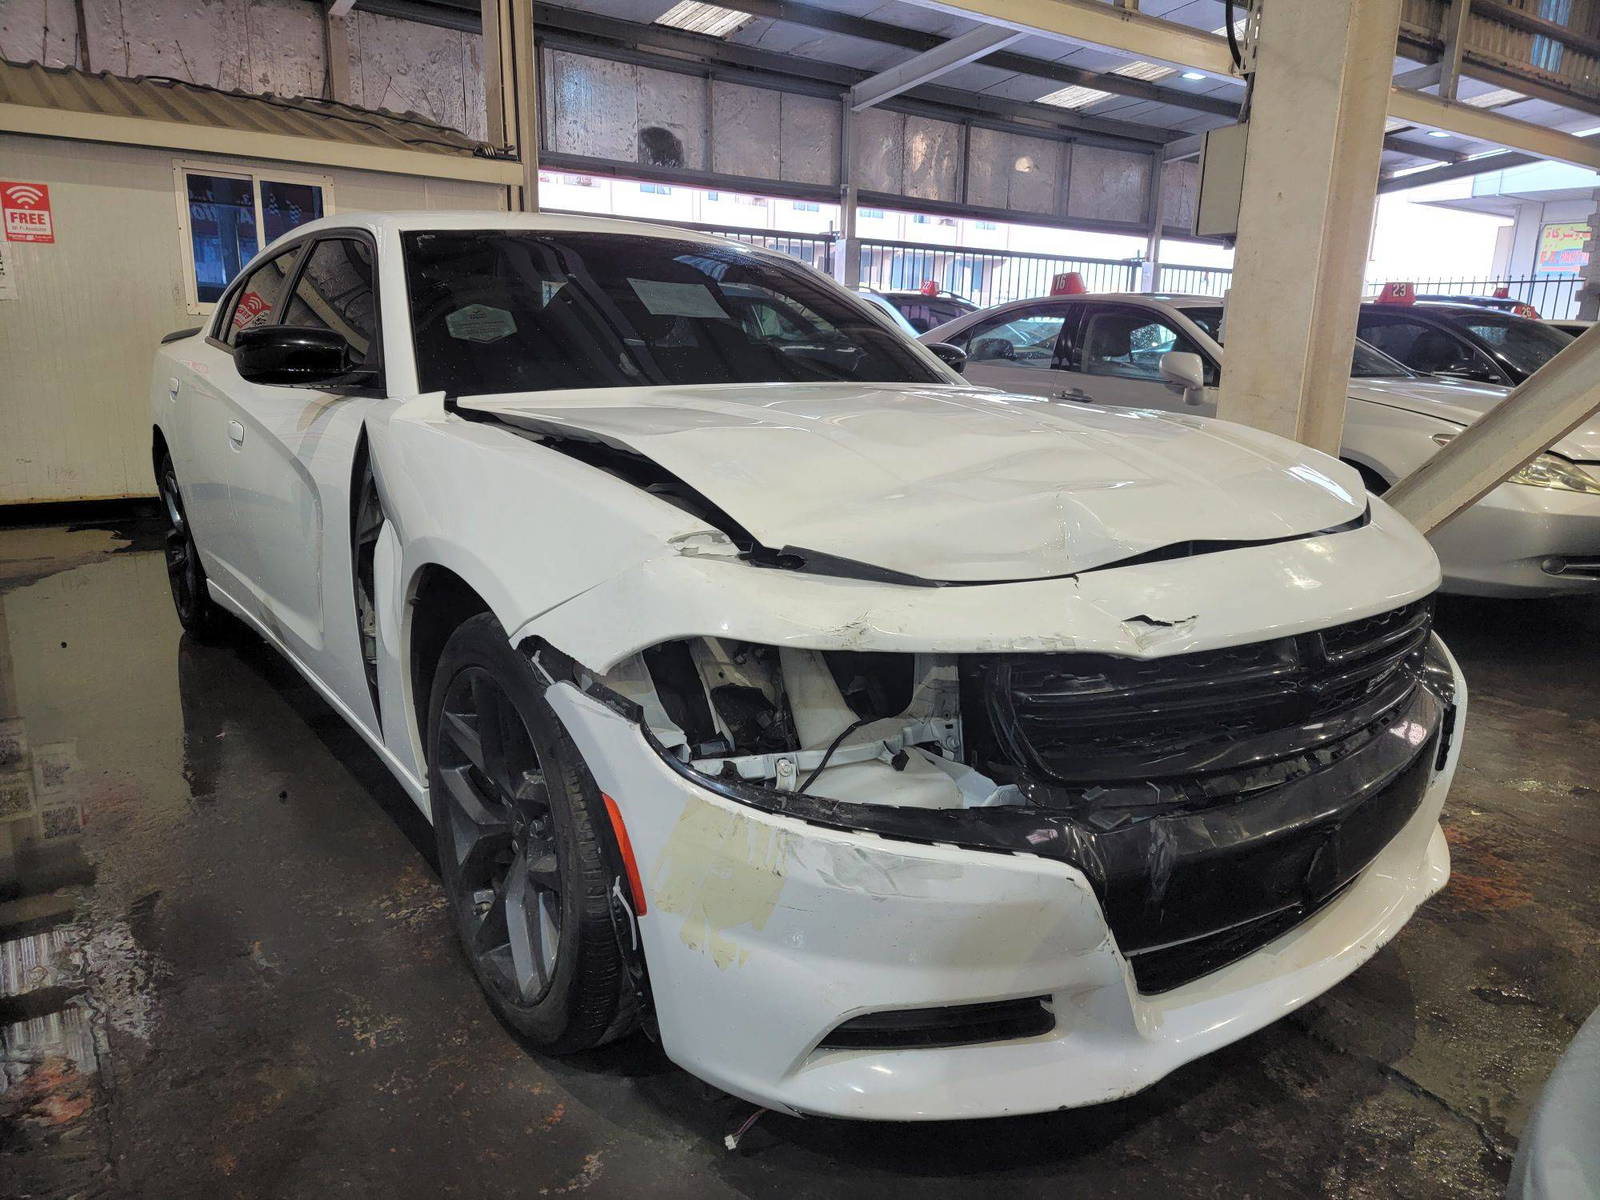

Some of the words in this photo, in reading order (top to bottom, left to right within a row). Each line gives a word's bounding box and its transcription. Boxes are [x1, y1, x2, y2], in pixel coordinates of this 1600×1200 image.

[10, 212, 46, 225] FREE
[1055, 274, 1067, 290] 16
[1392, 283, 1406, 297] 23
[1521, 306, 1532, 319] 26
